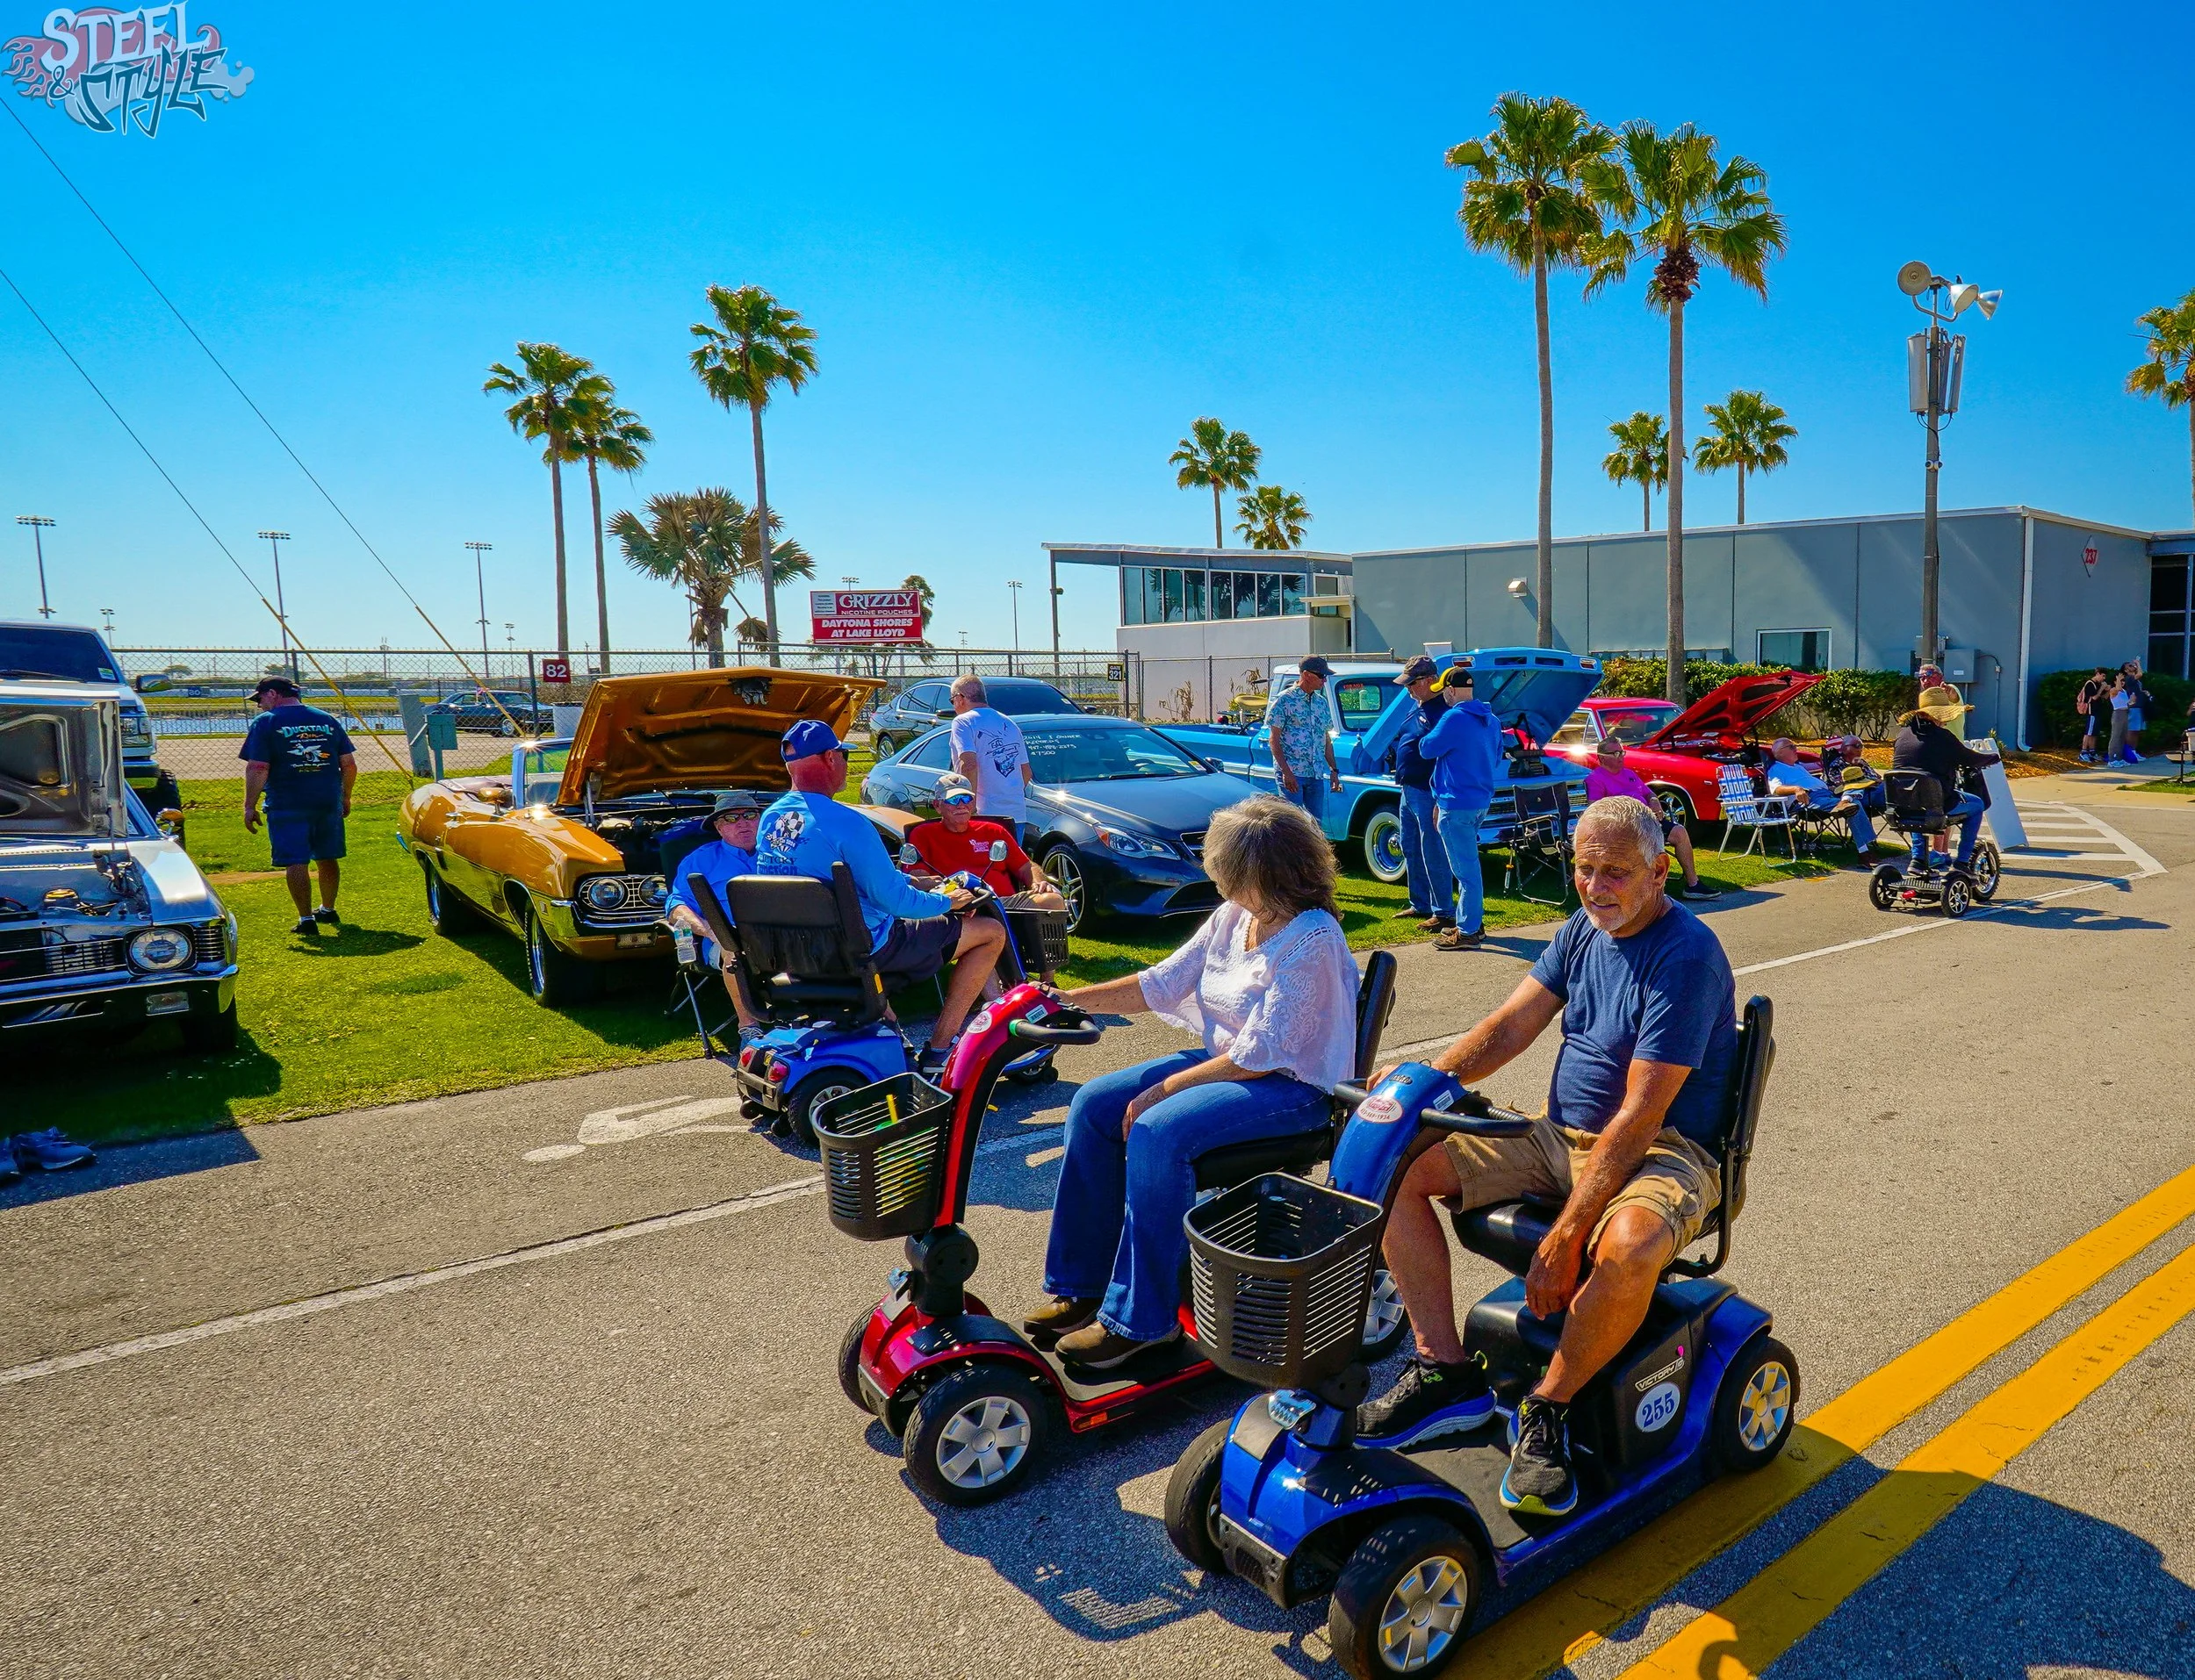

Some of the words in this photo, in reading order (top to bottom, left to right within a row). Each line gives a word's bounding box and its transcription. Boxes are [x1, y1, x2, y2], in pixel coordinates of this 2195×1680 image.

[838, 593, 915, 609] GRIZZLY
[822, 619, 871, 628] DAYTONA
[873, 618, 913, 627] SHORES
[874, 628, 906, 637] LLOYD
[546, 664, 567, 678] 82
[1109, 671, 1122, 680] 321
[281, 724, 334, 737] DUCKTAIL
[1638, 1364, 1675, 1389] VICTORY
[1642, 1390, 1675, 1428] 255
